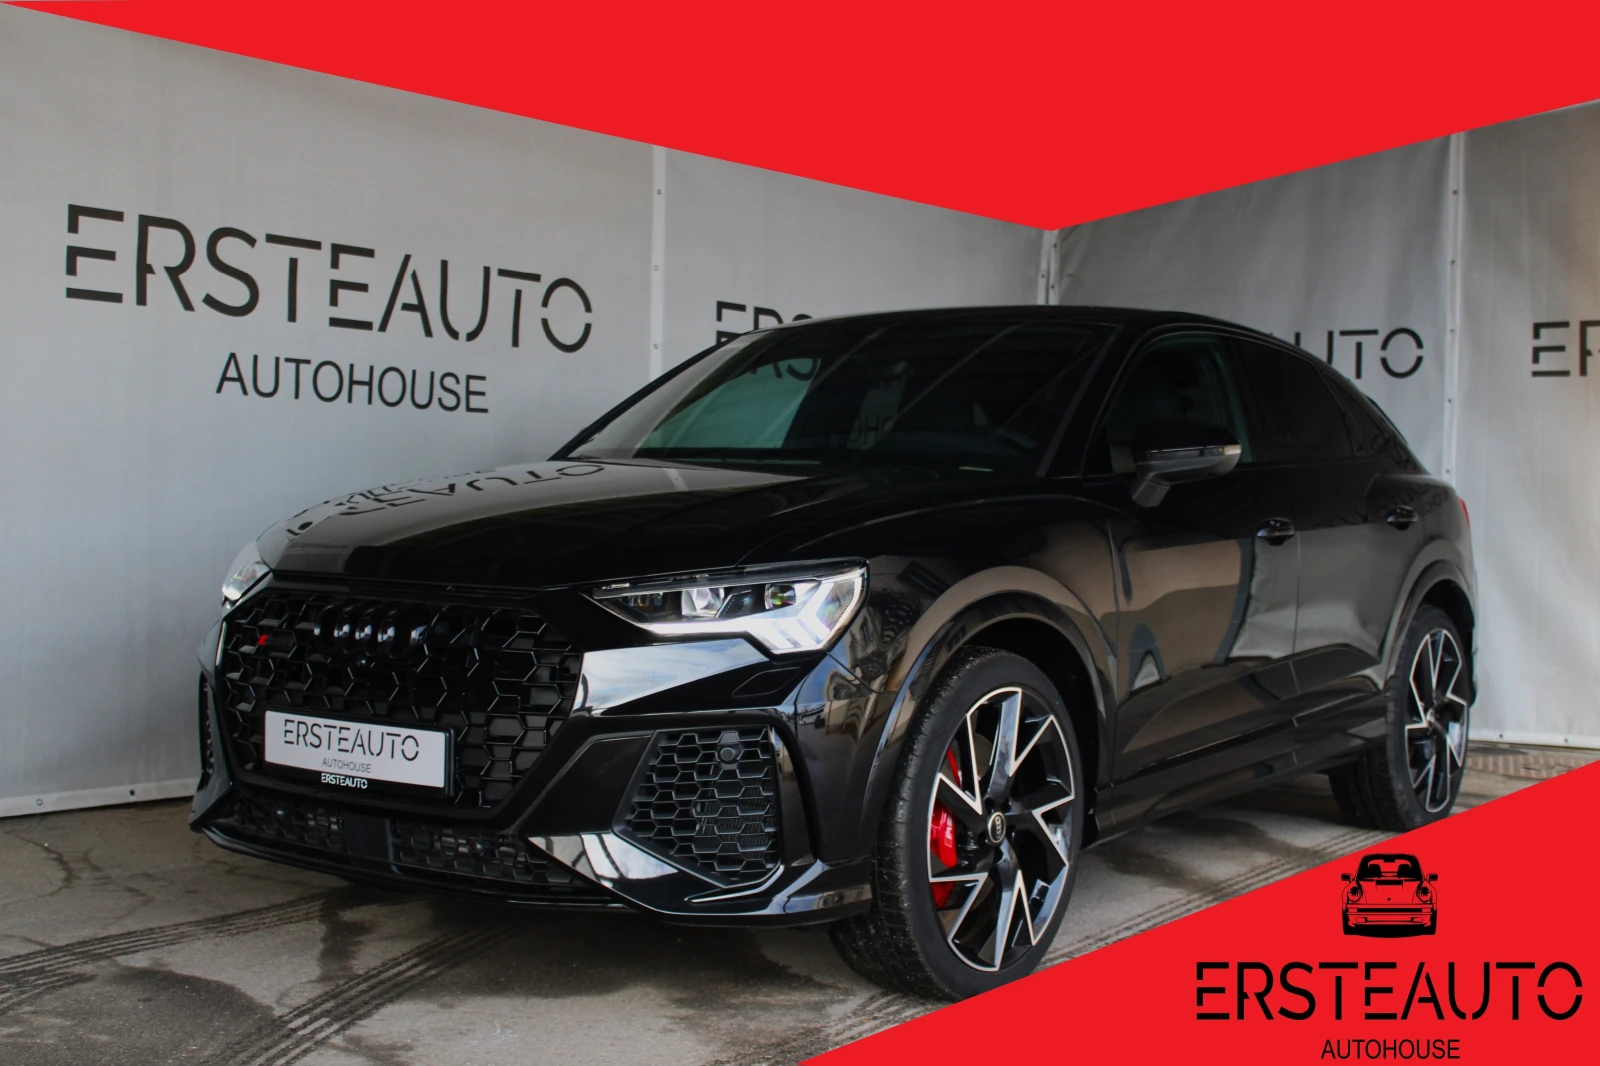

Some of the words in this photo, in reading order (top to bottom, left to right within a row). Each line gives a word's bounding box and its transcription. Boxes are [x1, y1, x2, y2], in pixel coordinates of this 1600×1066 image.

[66, 203, 592, 353] ERSTEAUTO
[215, 352, 489, 413] AUTOHOUSE
[284, 719, 419, 761] ERSTEAUTO
[320, 772, 368, 789] ERSTEAUTO
[321, 757, 372, 773] AUTOHOUSE
